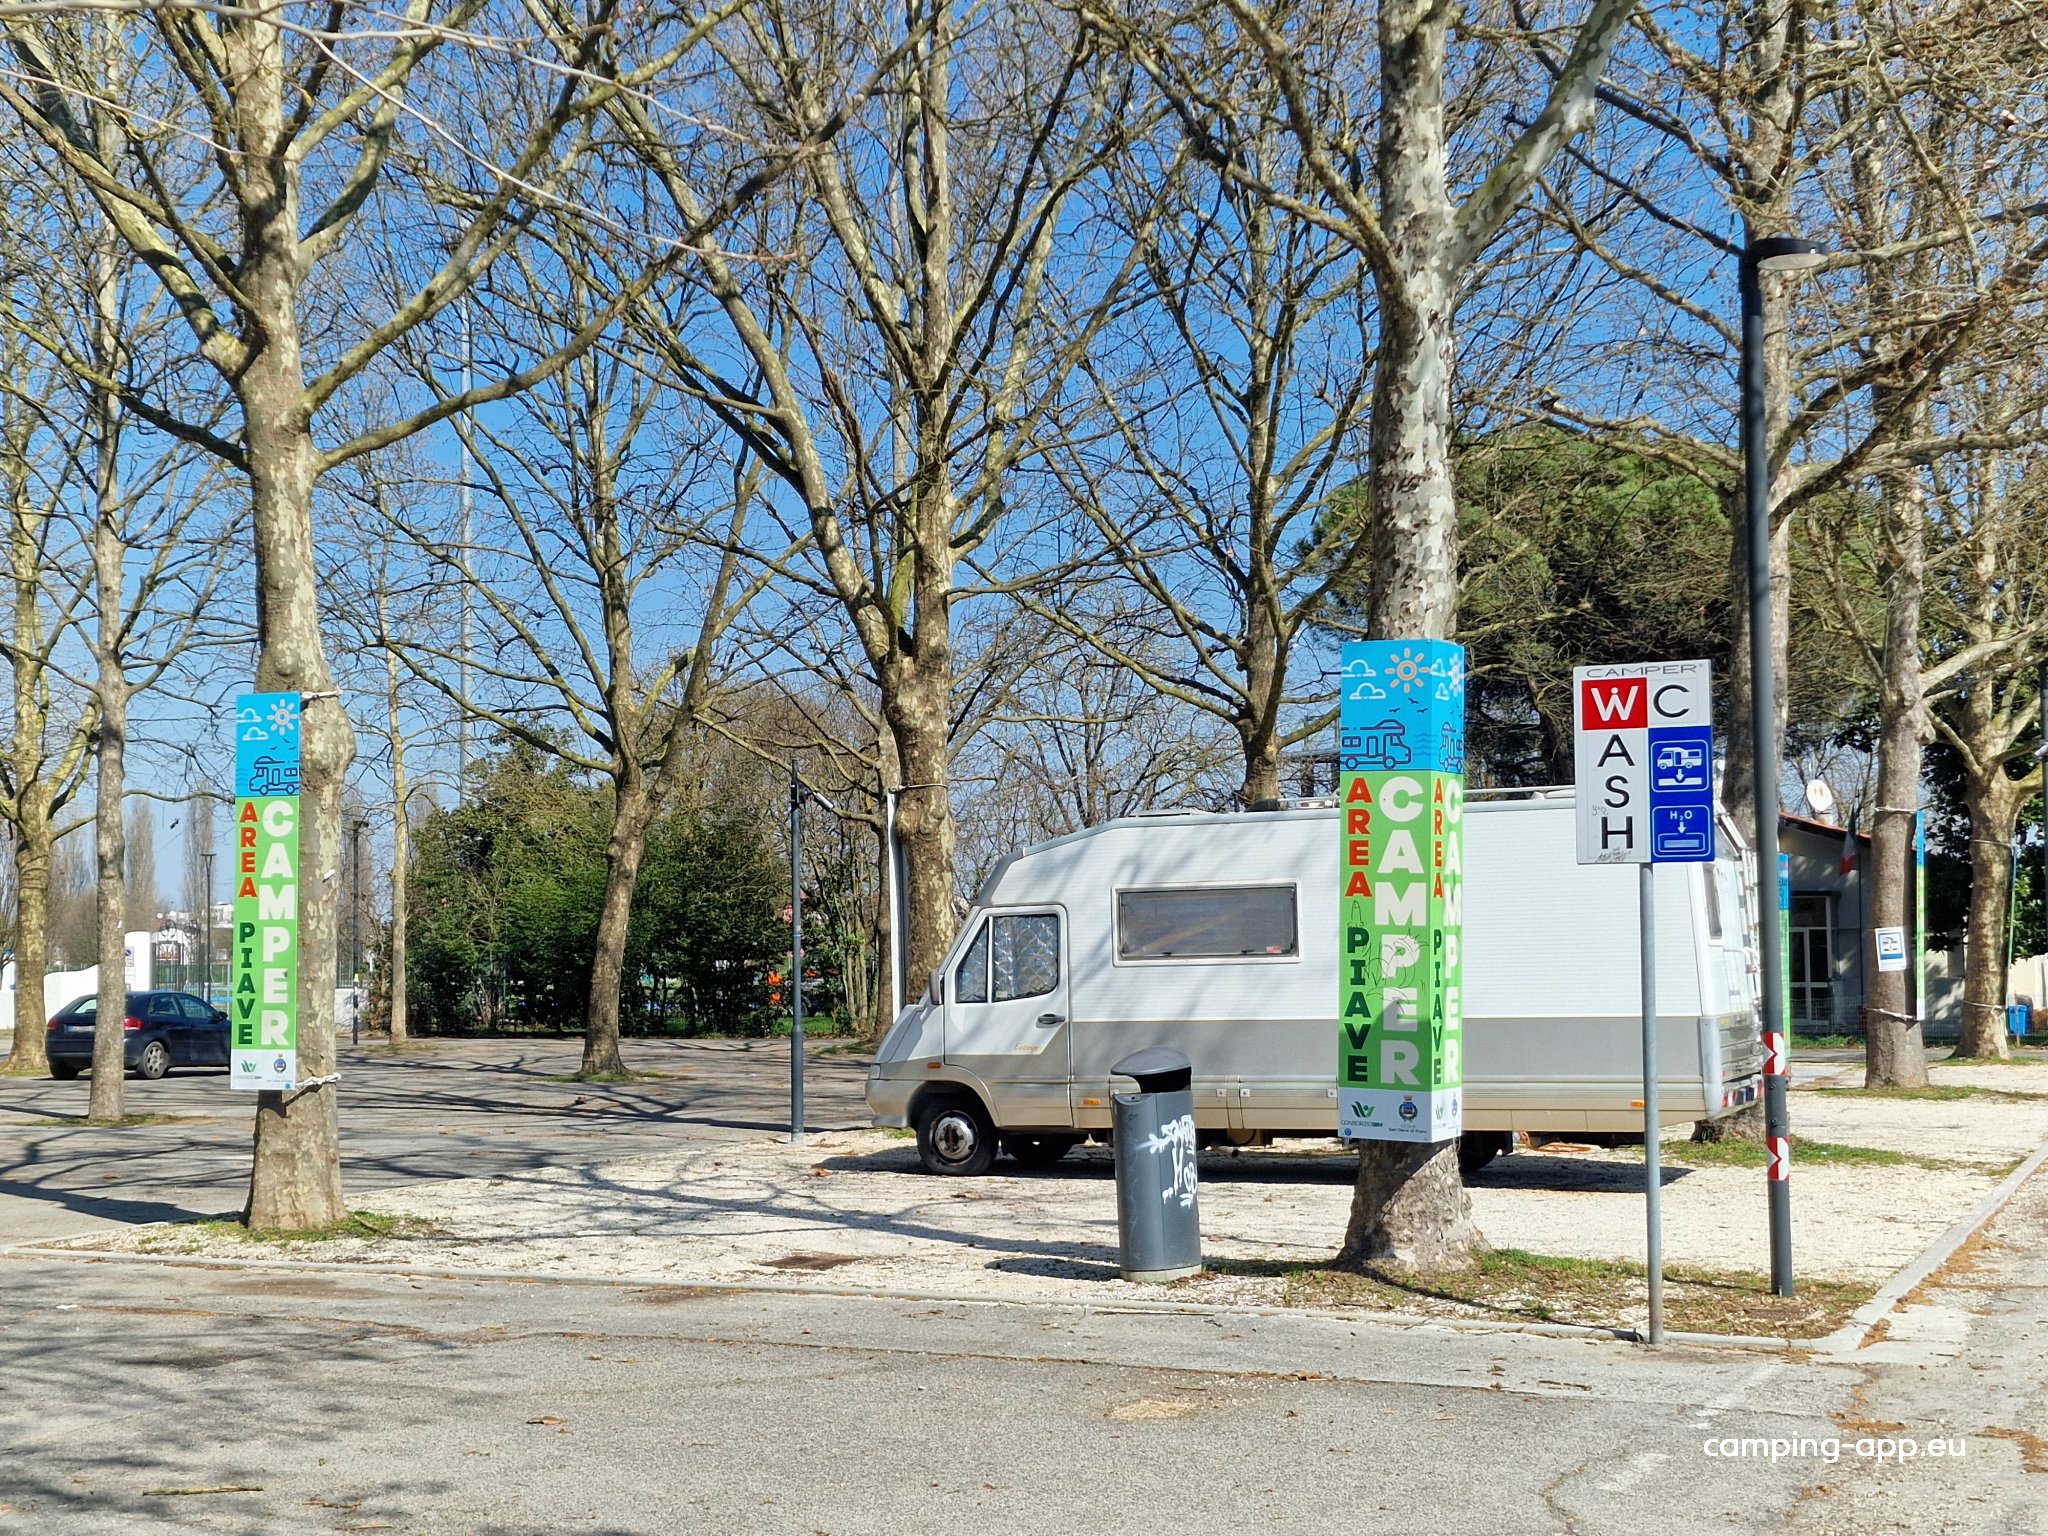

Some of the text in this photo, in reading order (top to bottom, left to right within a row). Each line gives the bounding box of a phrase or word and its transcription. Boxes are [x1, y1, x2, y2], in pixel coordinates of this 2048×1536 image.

[1586, 664, 1697, 678] CAMPER
[239, 801, 258, 897] AREA
[1345, 777, 1373, 898] AREA
[1433, 777, 1443, 899] AREA
[237, 921, 255, 1045] PIAVE
[260, 800, 295, 1045] CAMPER
[1374, 776, 1427, 1086] CAMPER
[1444, 779, 1462, 1085] CAMPER
[1344, 927, 1371, 1082] PIAVE
[1433, 928, 1442, 1085] PIAVE
